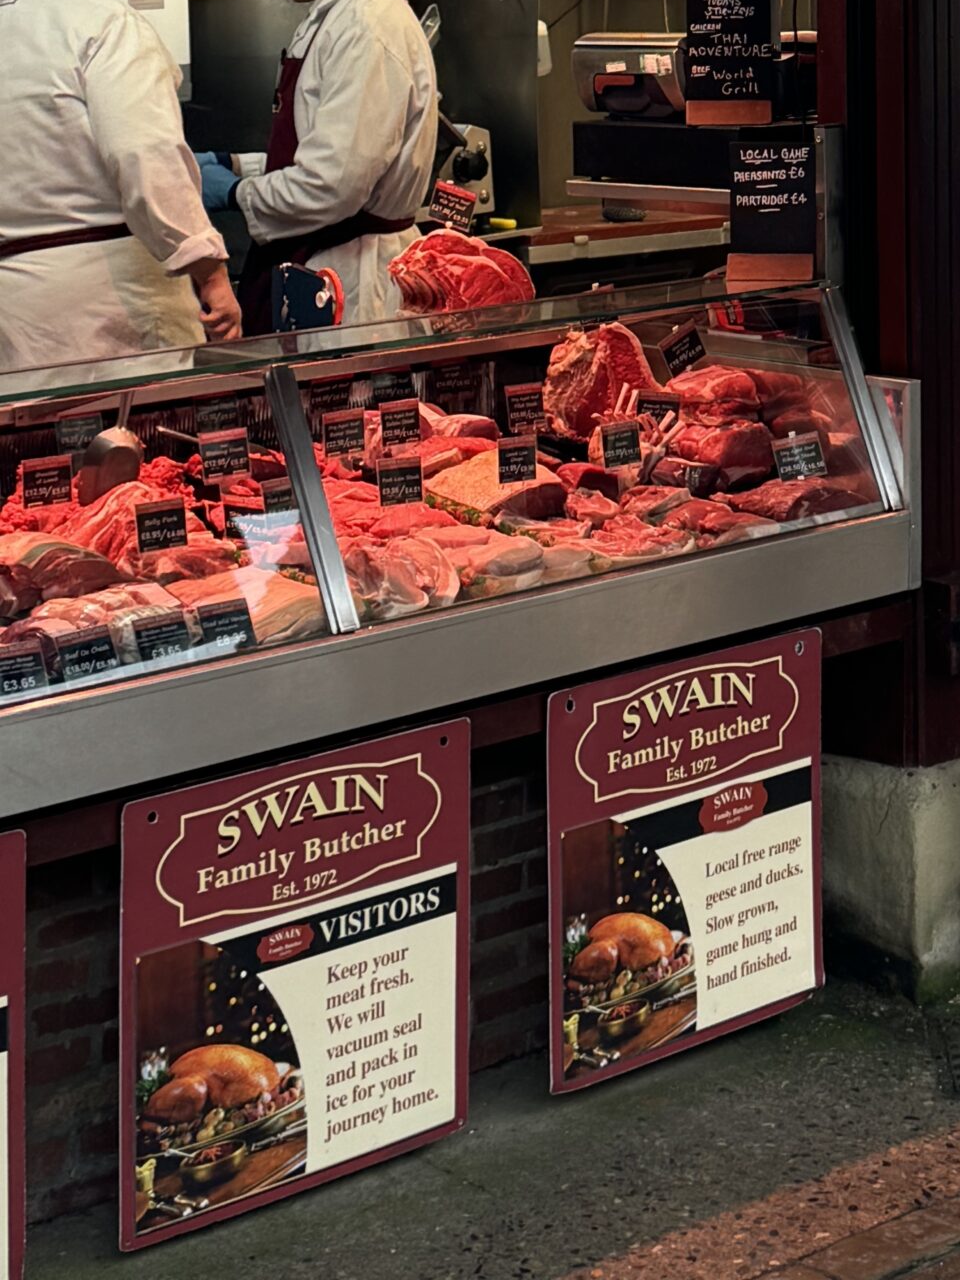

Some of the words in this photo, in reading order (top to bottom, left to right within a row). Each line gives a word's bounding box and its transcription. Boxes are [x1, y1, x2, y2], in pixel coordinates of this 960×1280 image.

[689, 44, 772, 57] ADVENTURE
[710, 33, 748, 44] THAI
[713, 67, 754, 81] World
[722, 81, 759, 95] Grill
[740, 148, 778, 160] LOCAL
[734, 169, 786, 183] PHEASANTS
[788, 167, 805, 179] £6
[736, 193, 789, 207] PARTRIDGE
[790, 192, 807, 205] £4
[152, 644, 182, 660] £3.65
[3, 676, 36, 692] £3.65
[622, 672, 756, 741] SWAIN
[607, 736, 683, 774] Family
[690, 713, 771, 751] Butcher
[666, 767, 688, 783] Est.
[691, 755, 717, 775] 1972
[217, 774, 388, 856] SWAIN
[196, 847, 295, 893] Family
[303, 818, 407, 864] Butcher
[705, 855, 739, 878] Local
[742, 848, 766, 866] free
[768, 834, 802, 858] range
[272, 880, 300, 901] Est.
[303, 868, 338, 895] 1972
[705, 888, 737, 911] geese
[740, 873, 762, 894] and
[765, 861, 804, 887] ducks.
[319, 886, 441, 943] VISITORS
[705, 912, 734, 935] Slow
[737, 898, 779, 927] grown,
[705, 940, 739, 966] game
[742, 924, 773, 950] hung
[774, 915, 798, 938] and
[326, 959, 368, 985] Keep
[372, 947, 409, 974] your
[706, 966, 737, 991] hand
[740, 947, 792, 977] finished.
[325, 984, 366, 1011] meat
[369, 968, 414, 996] fresh.
[326, 1015, 353, 1035] We
[357, 1000, 385, 1026] will
[326, 1028, 389, 1061] vacuum
[392, 1012, 422, 1039] seal
[325, 1061, 356, 1087] and
[361, 1048, 400, 1079] pack
[403, 1043, 418, 1061] in
[325, 1091, 348, 1113] ice
[351, 1081, 376, 1106] for
[379, 1068, 416, 1098] your
[324, 1102, 388, 1144] journey
[391, 1086, 439, 1116] home.
